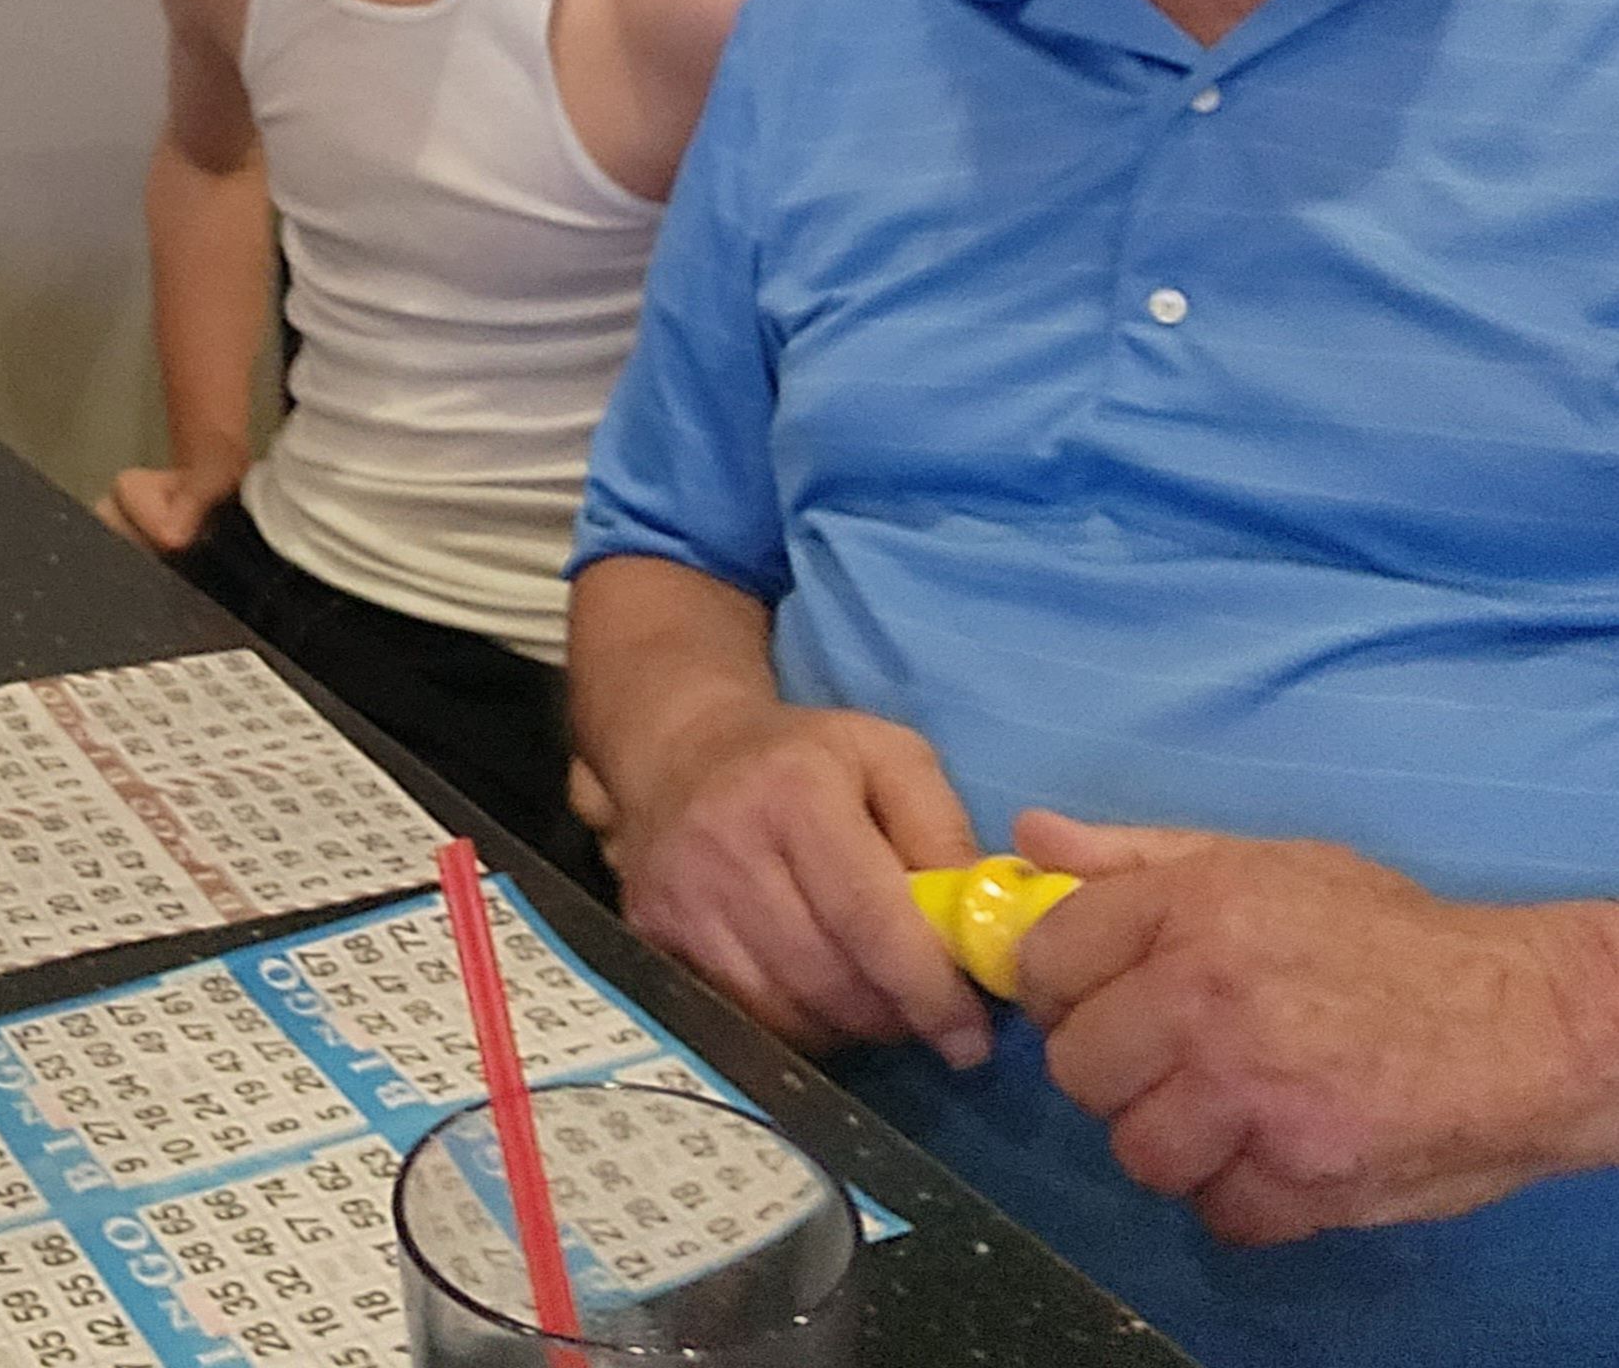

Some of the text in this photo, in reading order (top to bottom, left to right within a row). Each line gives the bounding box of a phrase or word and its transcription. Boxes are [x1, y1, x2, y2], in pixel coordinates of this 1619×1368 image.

[72, 859, 102, 878] 42
[46, 894, 99, 935] 2 20
[155, 902, 187, 920] 12
[20, 935, 51, 947] 7
[342, 933, 383, 965] 68
[386, 920, 458, 984] 52 72
[369, 974, 408, 993] 47
[154, 991, 193, 1015] 61
[177, 1023, 215, 1041] 47
[296, 951, 455, 1095] 14 27 32 54 67
[523, 1006, 591, 1055] 1 20
[608, 1028, 642, 1044] 5
[200, 975, 350, 1120] 5 26 37 55 69
[434, 1032, 477, 1055] 21
[205, 1049, 242, 1072] 43
[58, 1012, 200, 1165] 10 18 34 60 63
[104, 1004, 252, 1152] 15 24 49 67
[233, 1080, 271, 1105] 19
[10, 1024, 148, 1173] 9 27 33 53 75
[266, 1118, 300, 1134] 8
[306, 1161, 352, 1191] 62
[202, 1190, 247, 1220] 66
[339, 1198, 386, 1228] 59
[669, 1181, 744, 1244] 10 18
[232, 1226, 275, 1256] 46
[254, 1178, 399, 1321] 18 57 74
[576, 1217, 654, 1280] 12 27
[31, 1233, 129, 1346] 42 55 66
[148, 1204, 292, 1357] 28 35 58 65
[263, 1265, 312, 1299] 32
[1, 1289, 48, 1322] 59
[296, 1306, 342, 1337] 16
[27, 1330, 77, 1368] 35
